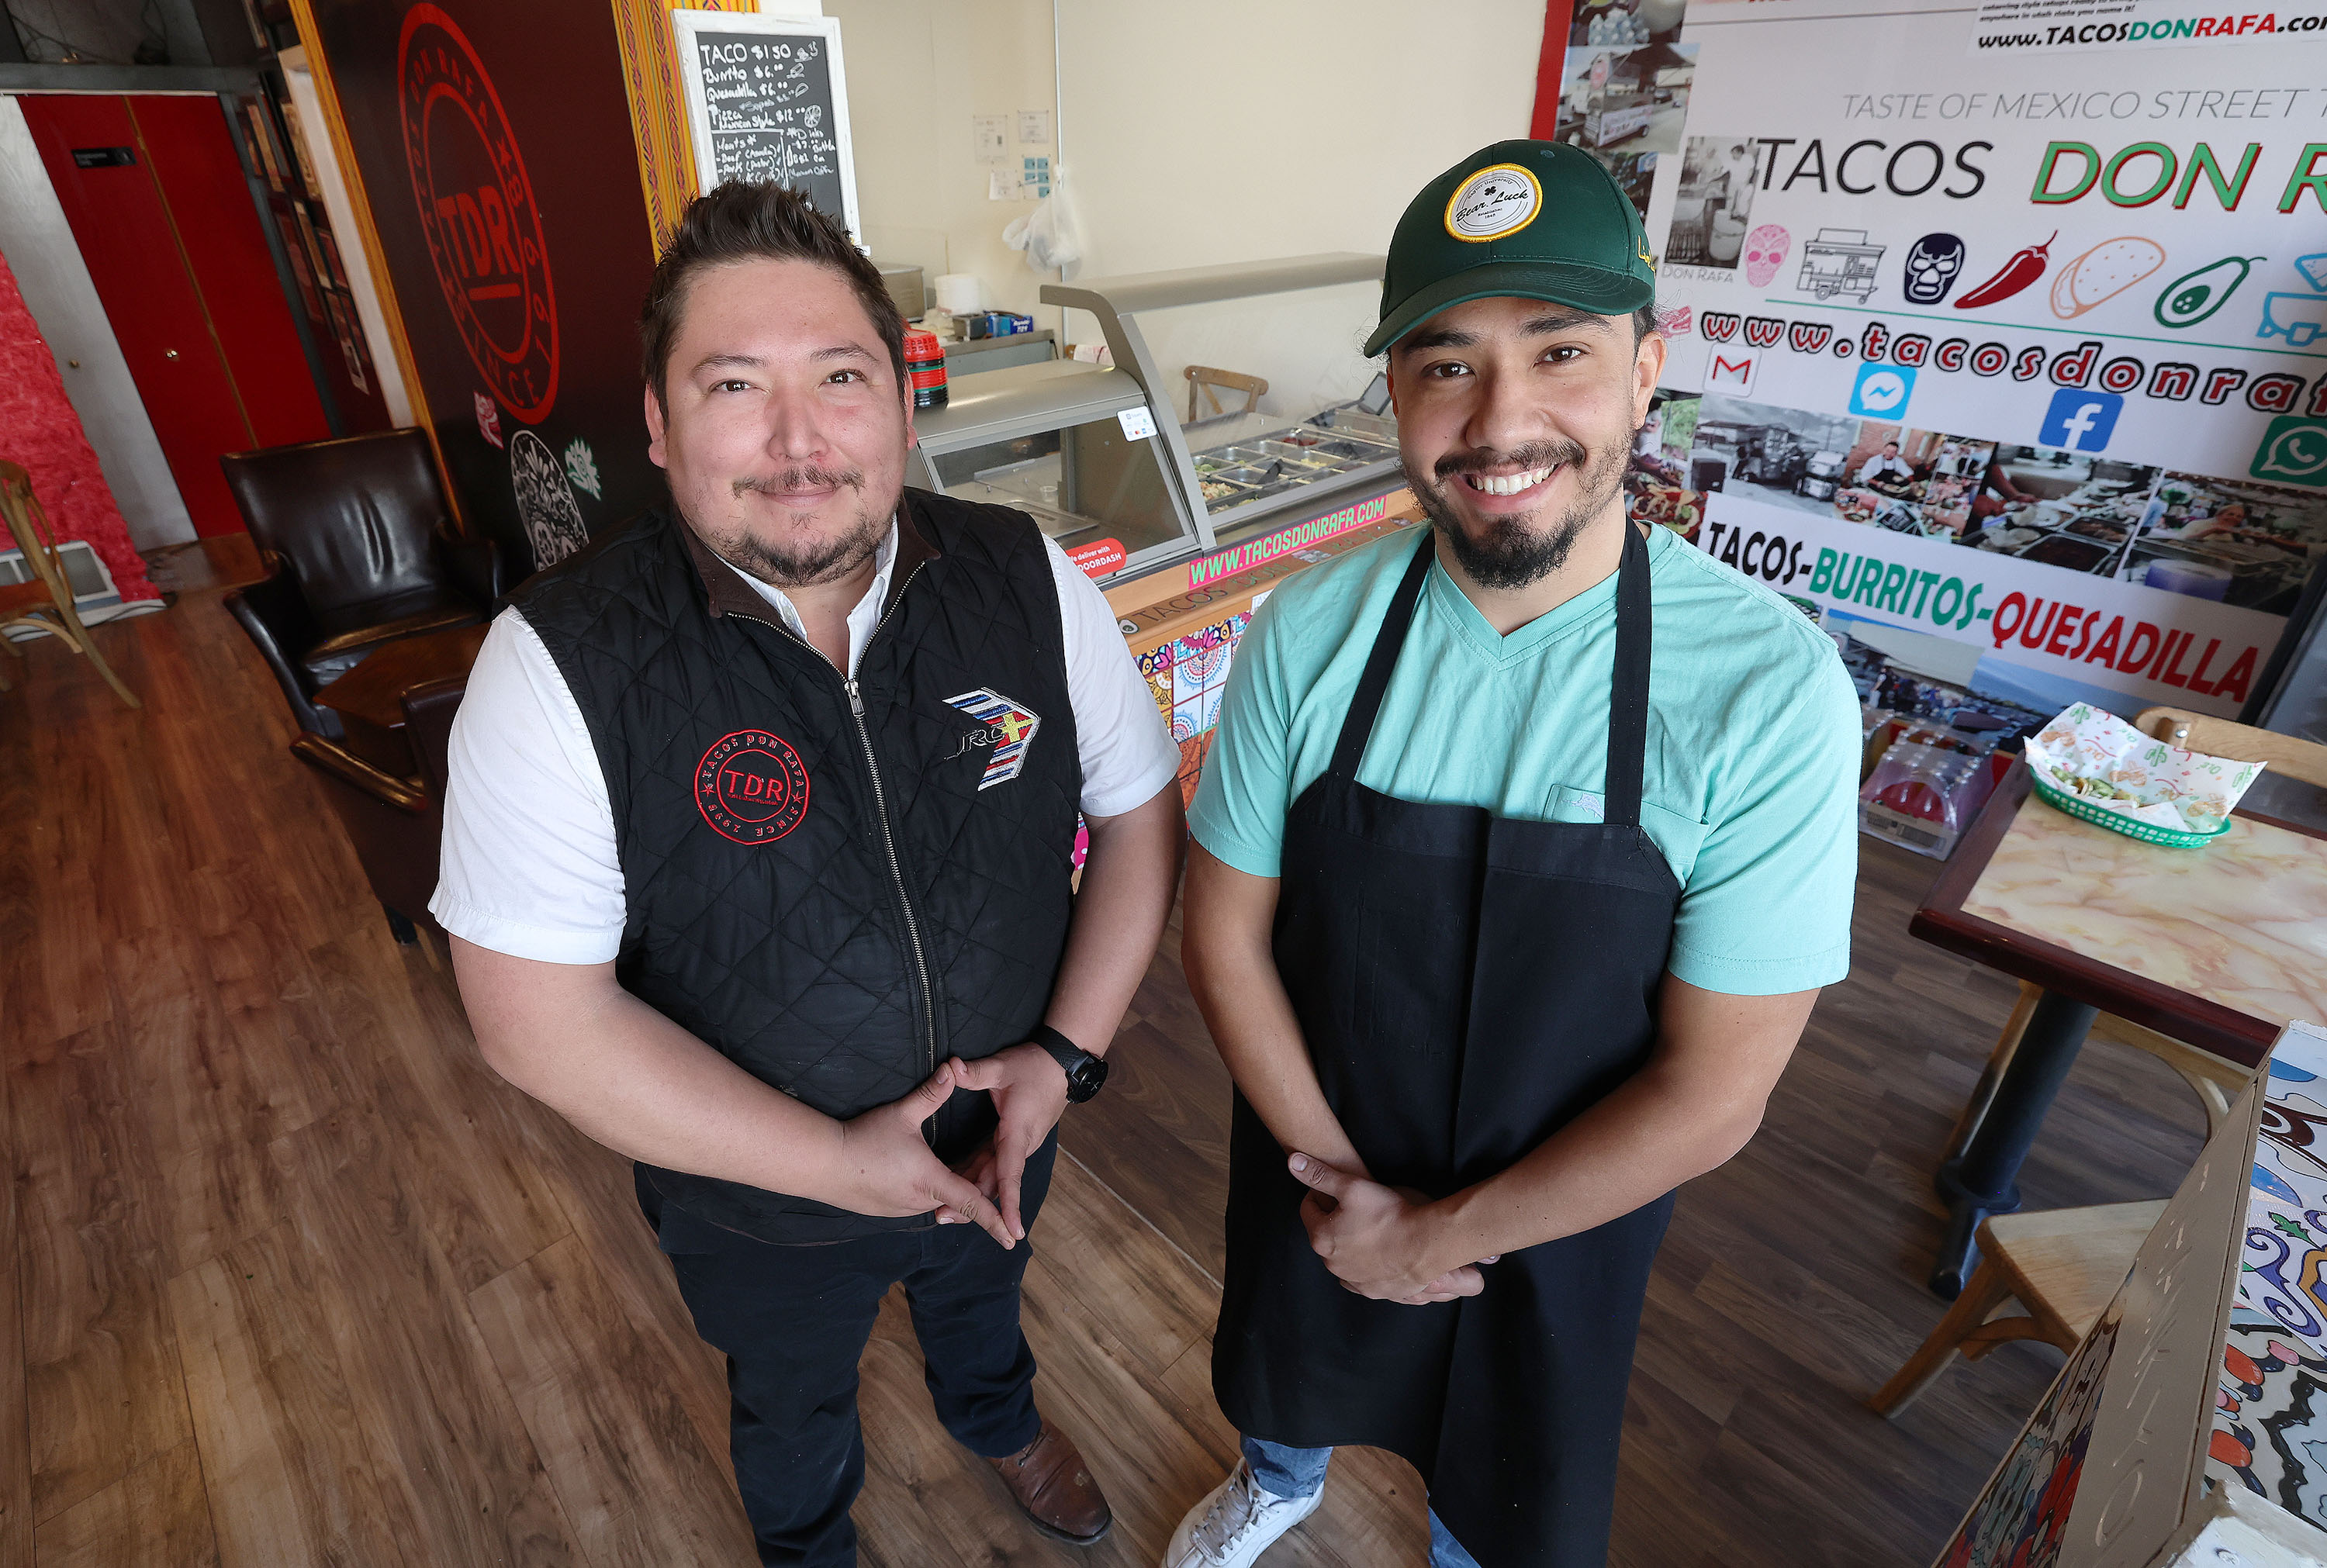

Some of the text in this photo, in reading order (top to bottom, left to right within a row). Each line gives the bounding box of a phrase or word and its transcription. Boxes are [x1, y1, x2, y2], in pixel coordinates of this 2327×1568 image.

[700, 43, 748, 66] TACO
[1843, 93, 1933, 119] TASTE
[1939, 92, 1987, 119] OF
[1993, 92, 2140, 119] MEXICO
[2149, 88, 2310, 119] STREET
[1757, 138, 1994, 199] TACOS
[2030, 141, 2263, 212] DON
[1491, 188, 1529, 205] Luck
[436, 185, 522, 279] TDR
[1661, 265, 1694, 280] DON
[1077, 550, 1098, 561] deliver
[1098, 545, 1112, 554] with
[1191, 496, 1385, 585] WWW.TACOSDONRAFA.COM
[1077, 552, 1122, 572] DOORDASH
[1132, 586, 1229, 622] TACOS
[701, 734, 804, 787] TACOS DON RAFA
[724, 769, 784, 802] TDR
[755, 806, 799, 838] SINCE
